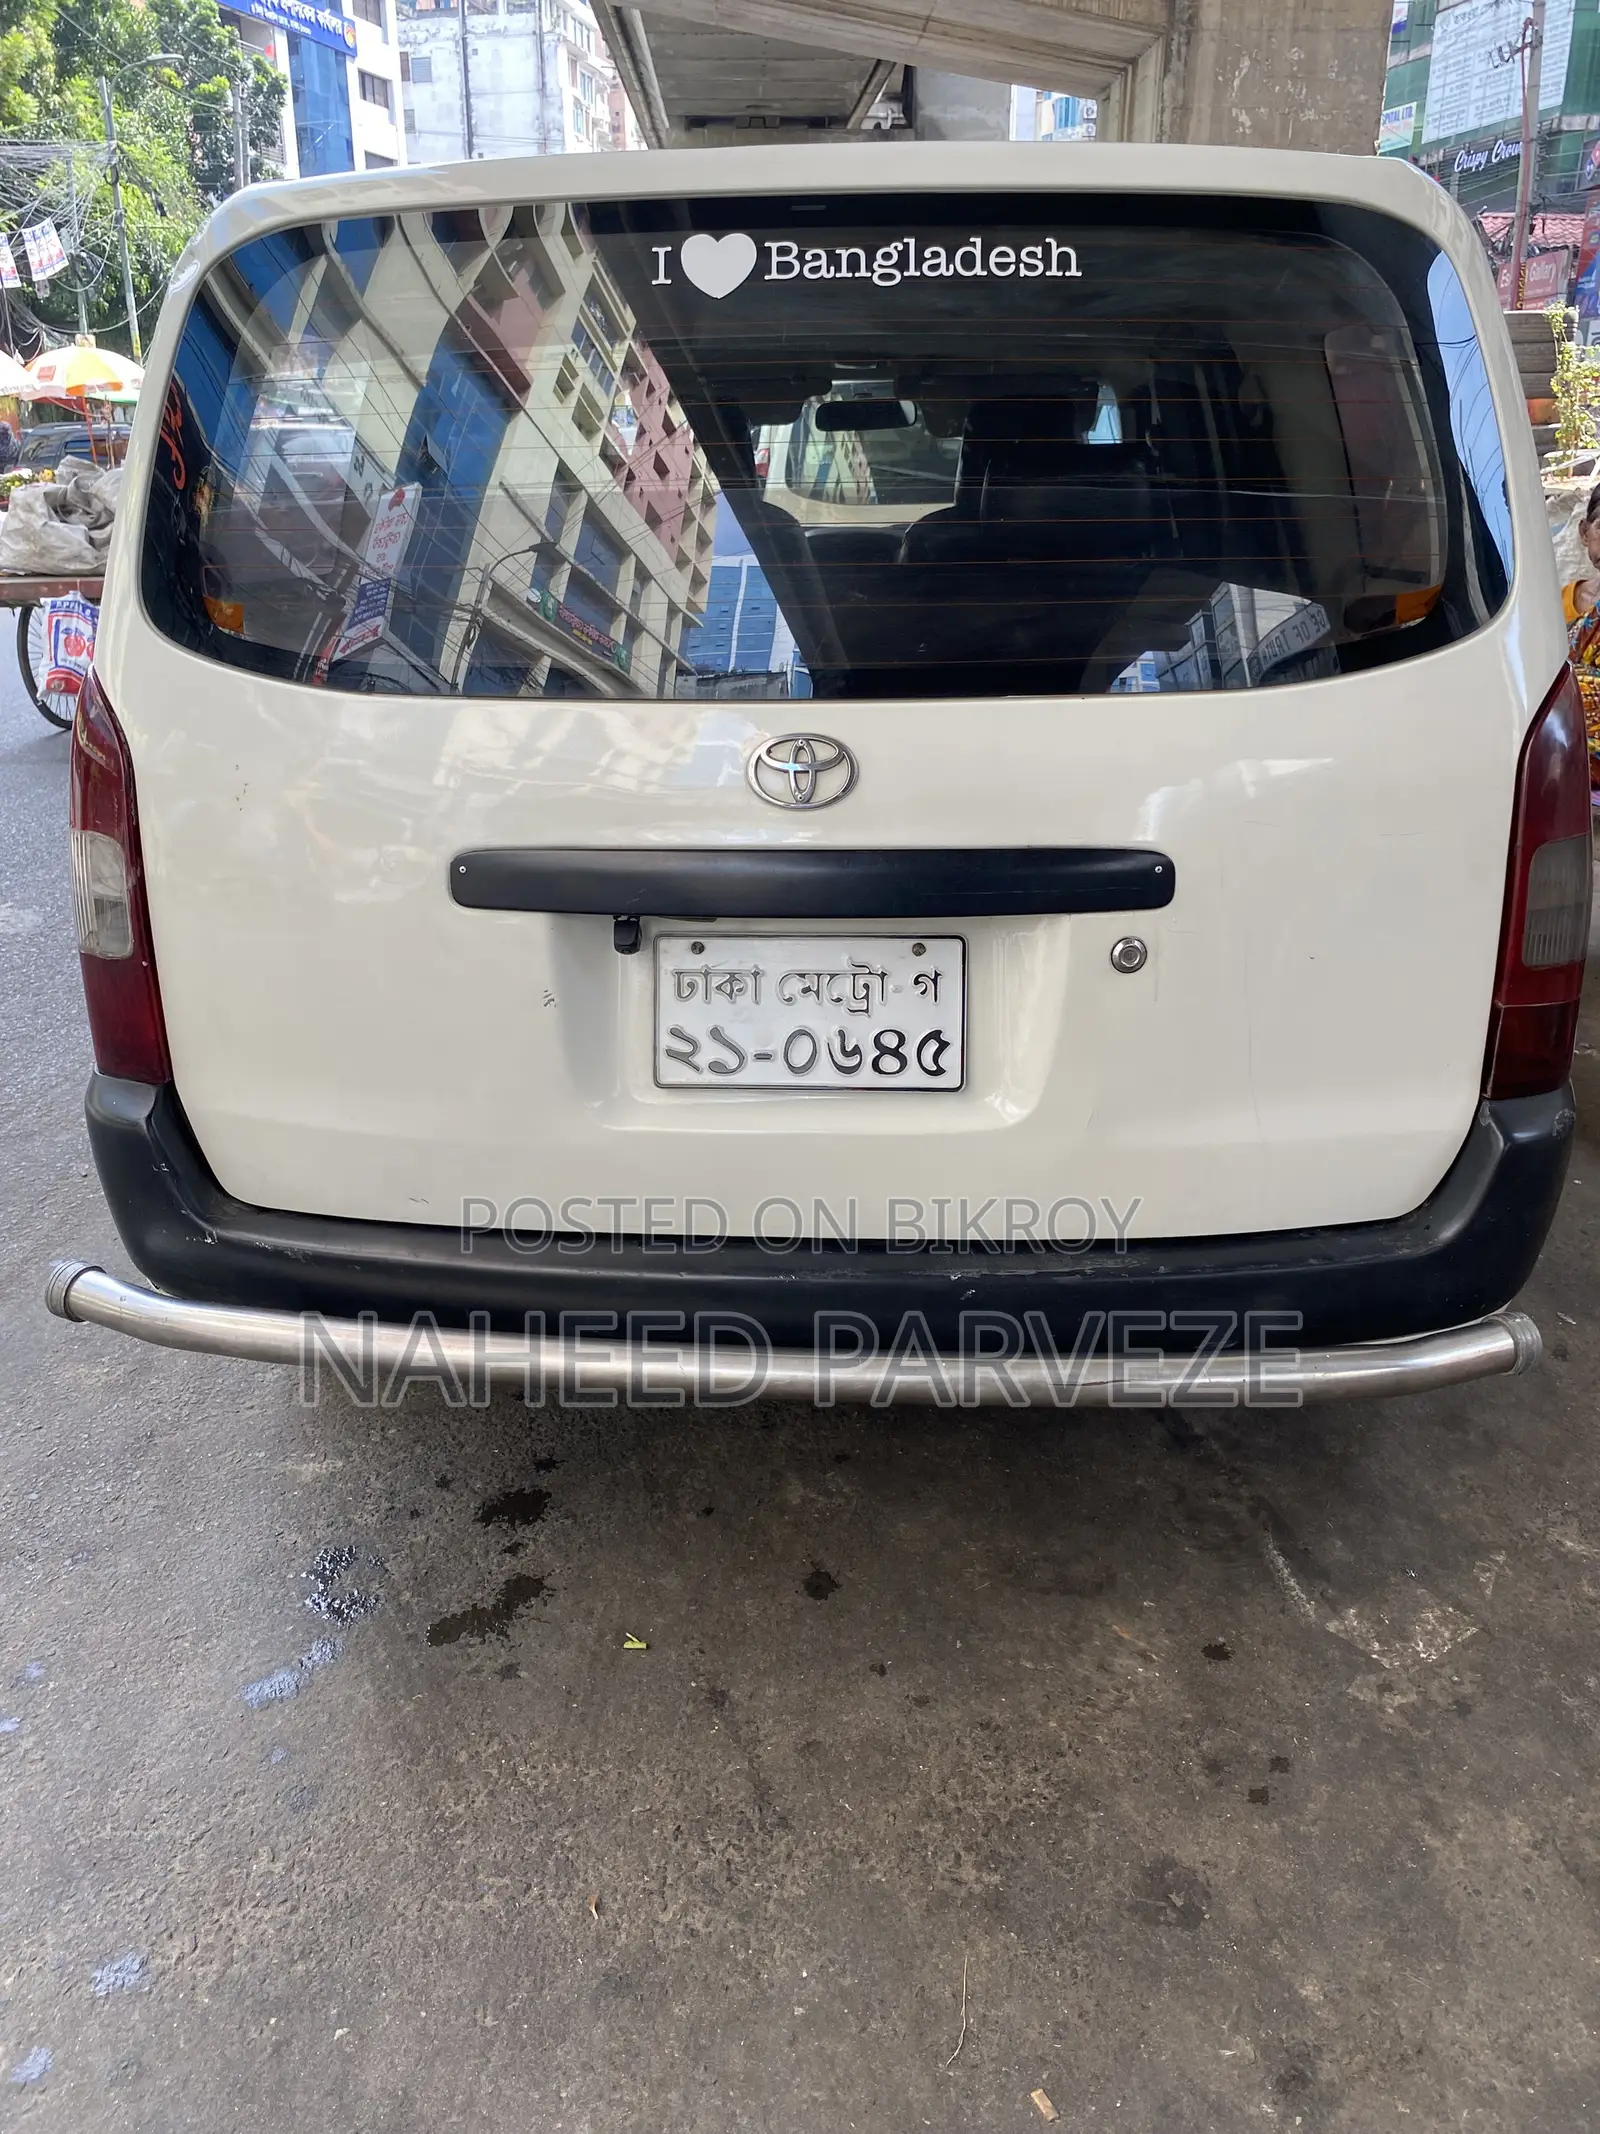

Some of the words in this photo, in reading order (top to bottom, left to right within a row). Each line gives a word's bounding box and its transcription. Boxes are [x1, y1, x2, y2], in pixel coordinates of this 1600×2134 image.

[1454, 150, 1489, 172] Crispy
[1492, 139, 1522, 163] Crow
[651, 246, 672, 285] I
[764, 237, 1082, 286] Bangladesh
[671, 964, 763, 1005] ঢাকা
[776, 957, 892, 1019] মেট্রো
[911, 966, 944, 1004] গ
[663, 1024, 953, 1078] ২১-০৬৪৫
